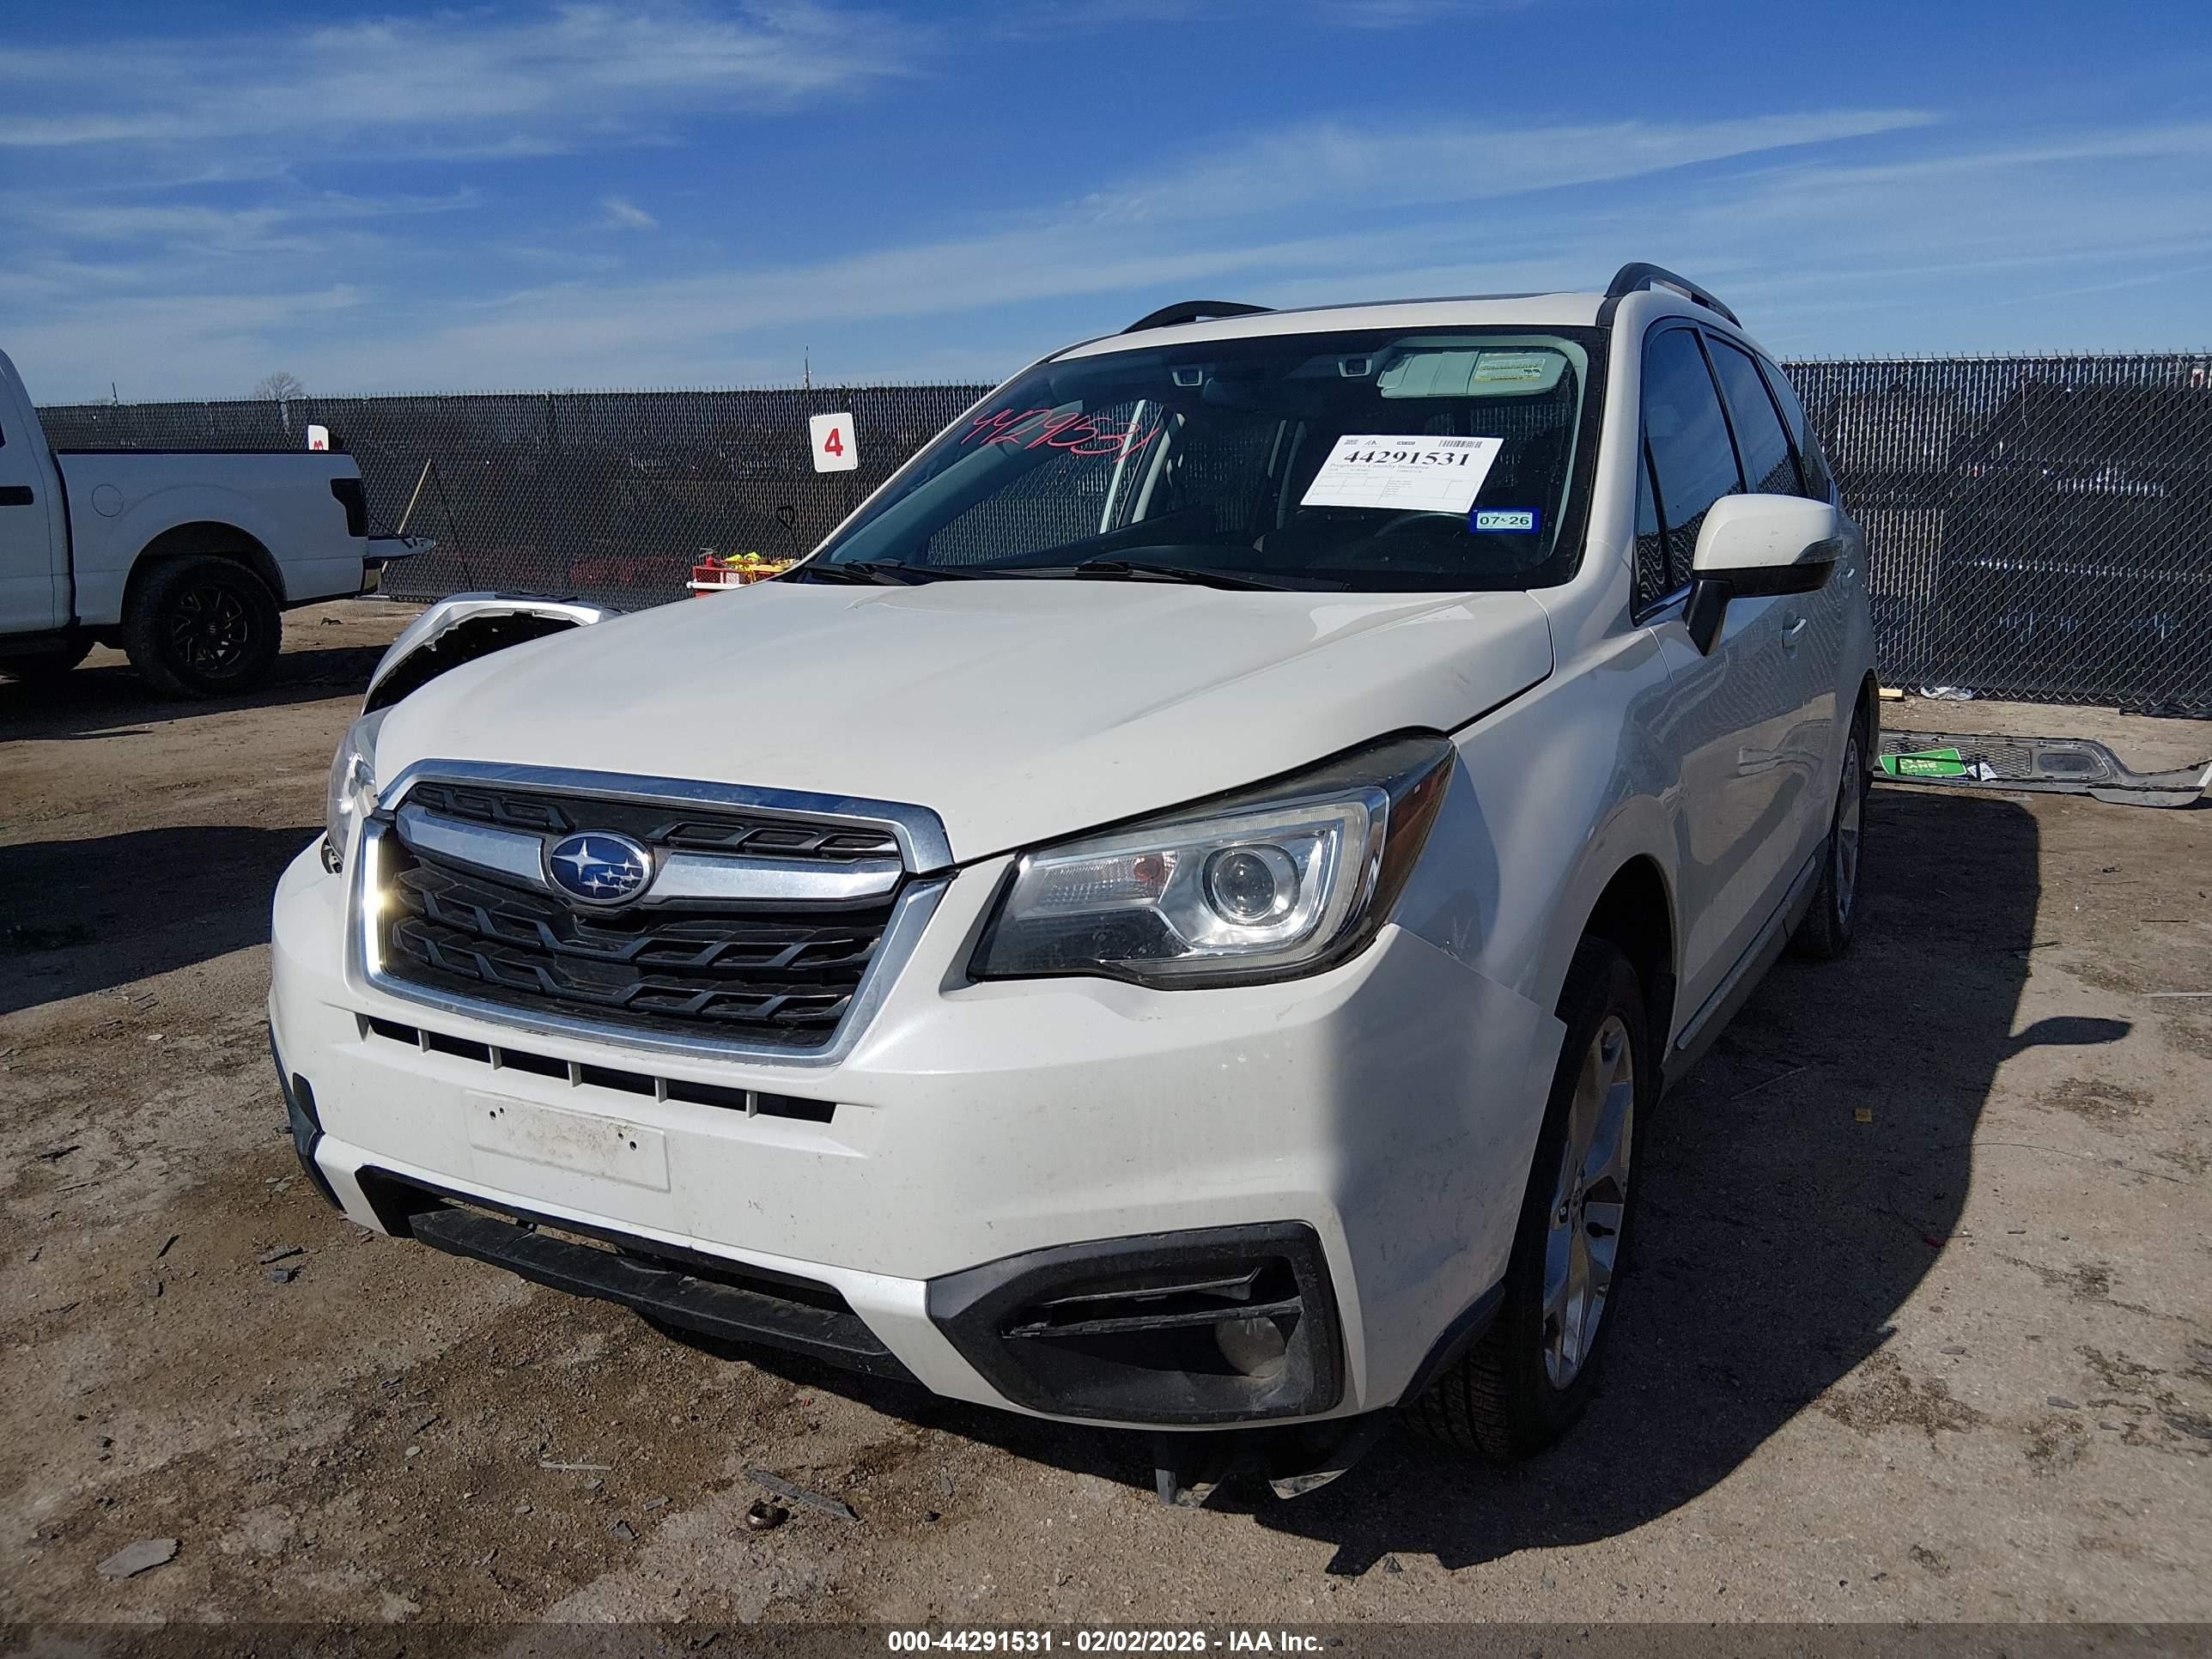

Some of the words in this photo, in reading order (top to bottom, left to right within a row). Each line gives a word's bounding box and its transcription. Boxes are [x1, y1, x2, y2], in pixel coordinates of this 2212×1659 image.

[824, 428, 844, 457] 4
[1343, 451, 1470, 467] 44291531
[1480, 516, 1500, 525] 07
[1509, 516, 1529, 525] 26
